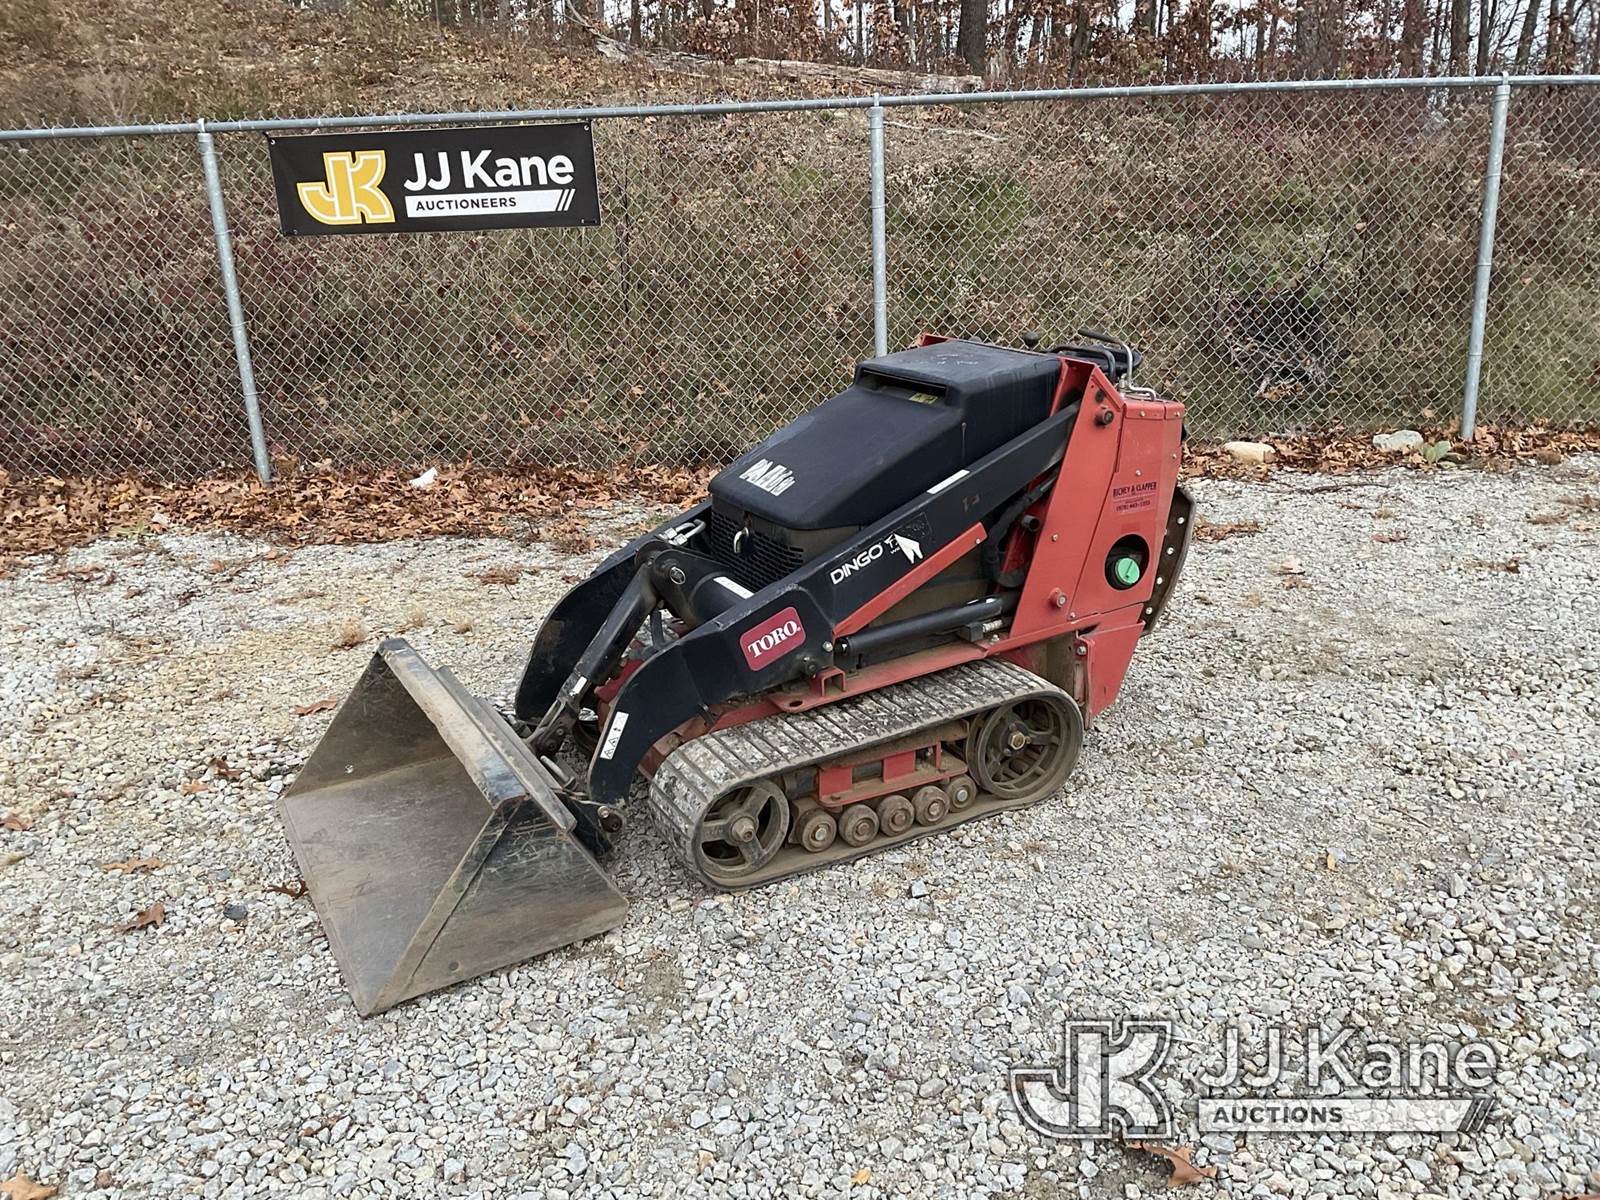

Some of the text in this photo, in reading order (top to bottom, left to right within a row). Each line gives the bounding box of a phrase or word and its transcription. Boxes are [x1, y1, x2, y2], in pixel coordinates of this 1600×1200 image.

[403, 149, 575, 192] JJ Kane
[415, 197, 517, 212] AUCTIONEERS
[830, 543, 884, 584] DINGO
